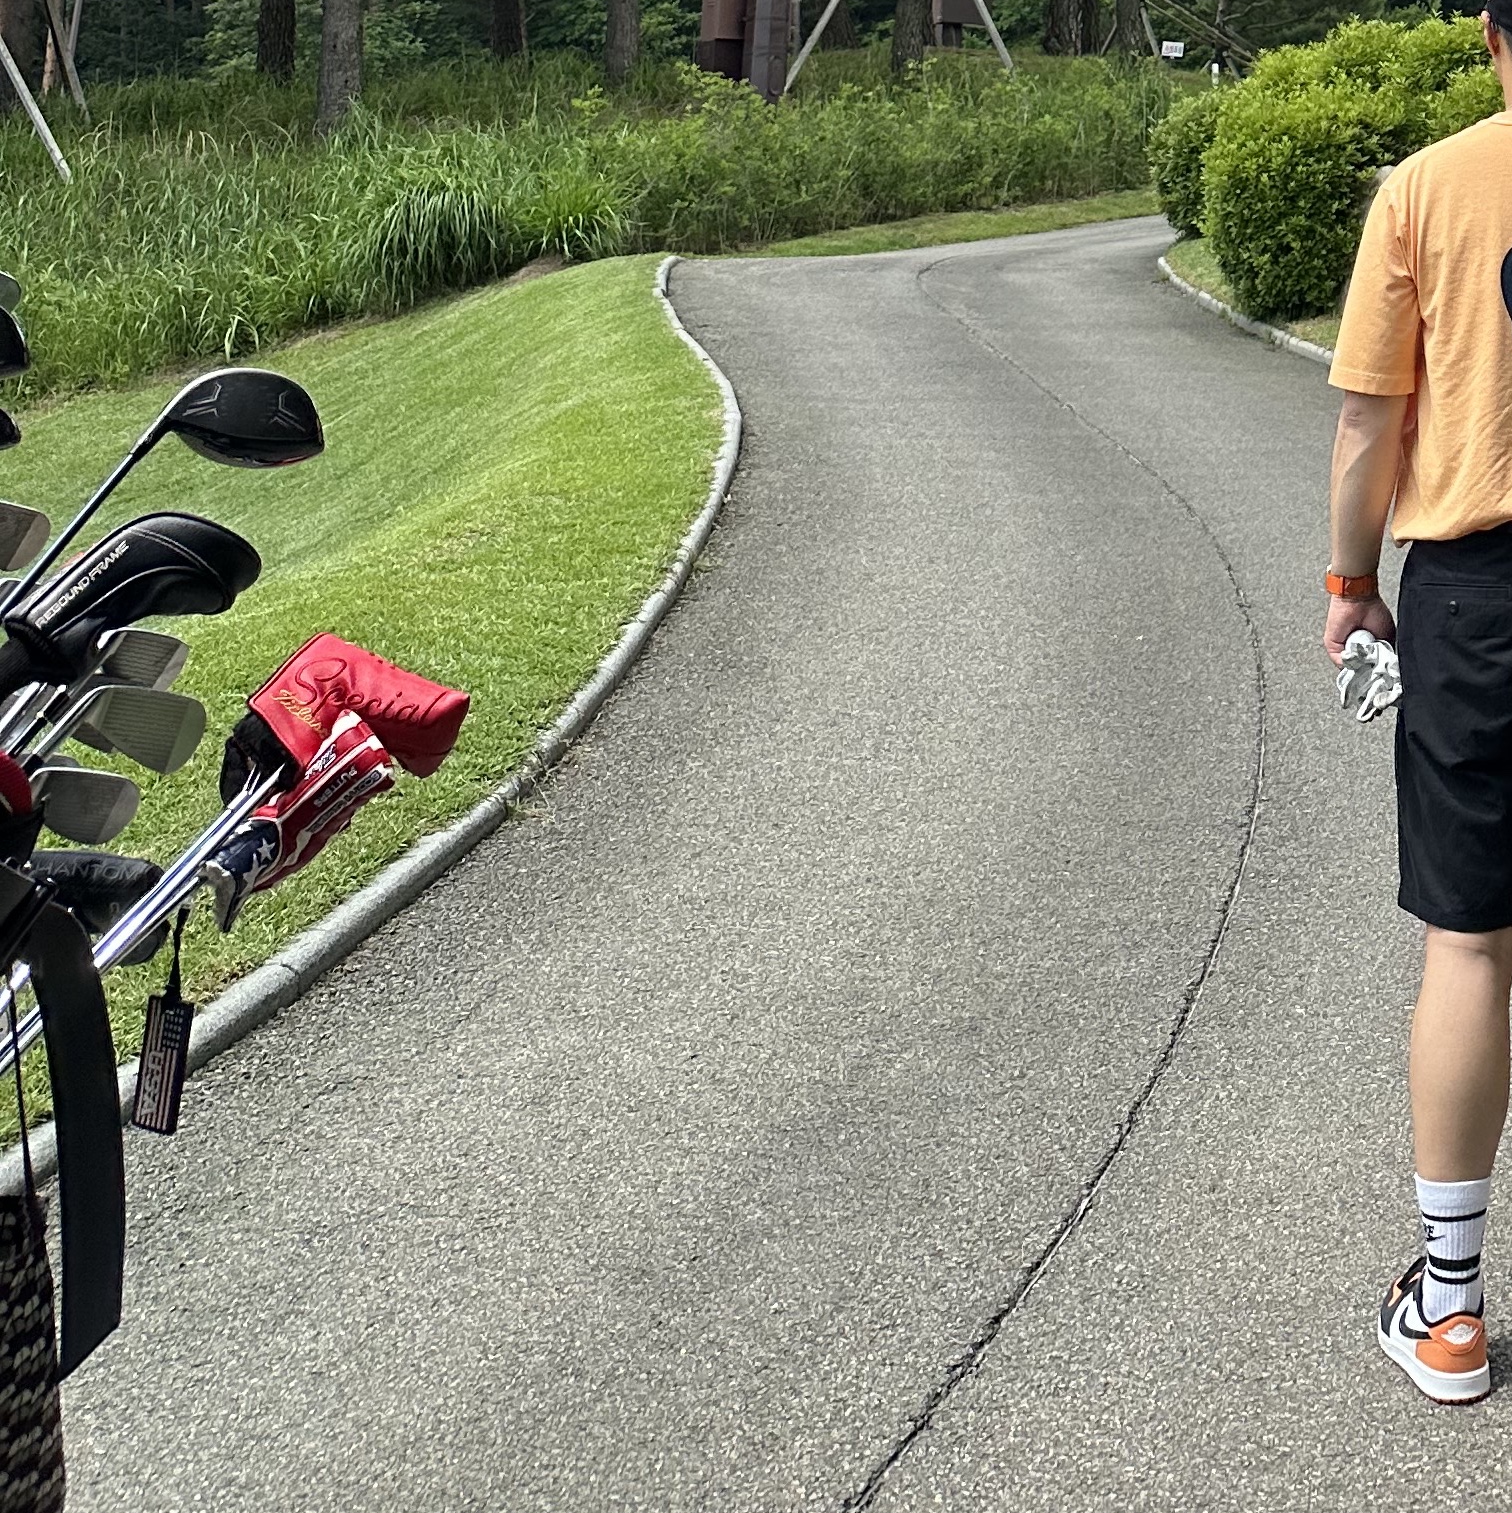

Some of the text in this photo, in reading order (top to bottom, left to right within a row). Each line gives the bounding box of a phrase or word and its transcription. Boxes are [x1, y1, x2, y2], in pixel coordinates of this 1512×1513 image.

[35, 540, 130, 630] REBOUND FRAME
[295, 658, 448, 729] Special
[36, 861, 140, 882] HANTOM
[141, 1050, 165, 1116] USA
